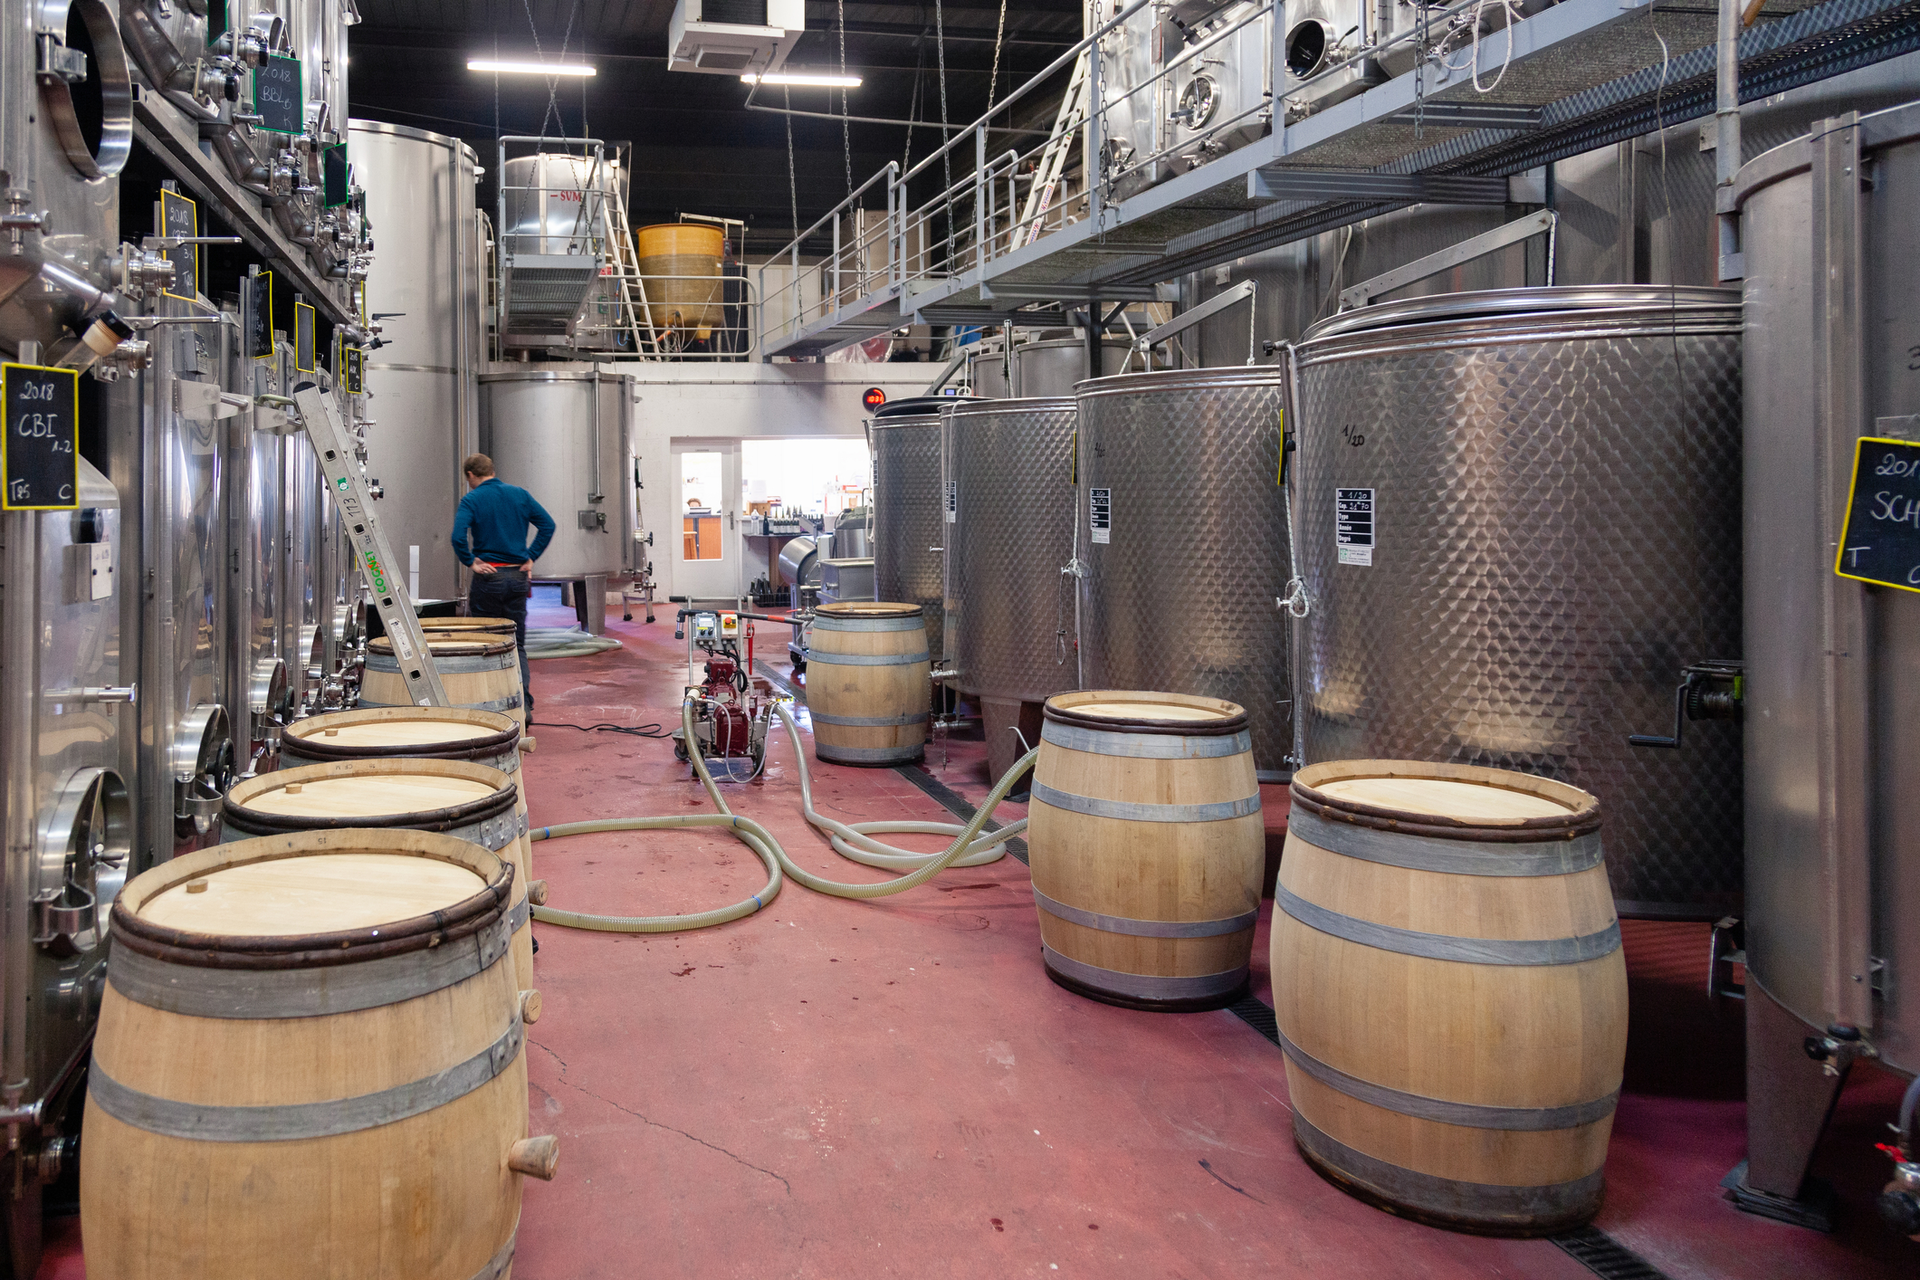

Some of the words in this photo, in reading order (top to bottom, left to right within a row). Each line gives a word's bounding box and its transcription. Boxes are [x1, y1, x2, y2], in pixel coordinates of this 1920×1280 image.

[560, 190, 582, 202] SVM
[169, 206, 189, 226] 2018
[19, 381, 55, 401] 2018
[19, 413, 58, 438] CBI
[1341, 424, 1365, 447] 1/20
[51, 440, 72, 453] 1-2
[1875, 453, 1920, 478] 201
[58, 483, 72, 500] C
[1847, 546, 1872, 568] T
[364, 550, 387, 594] COGNET
[318, 837, 327, 845] 15
